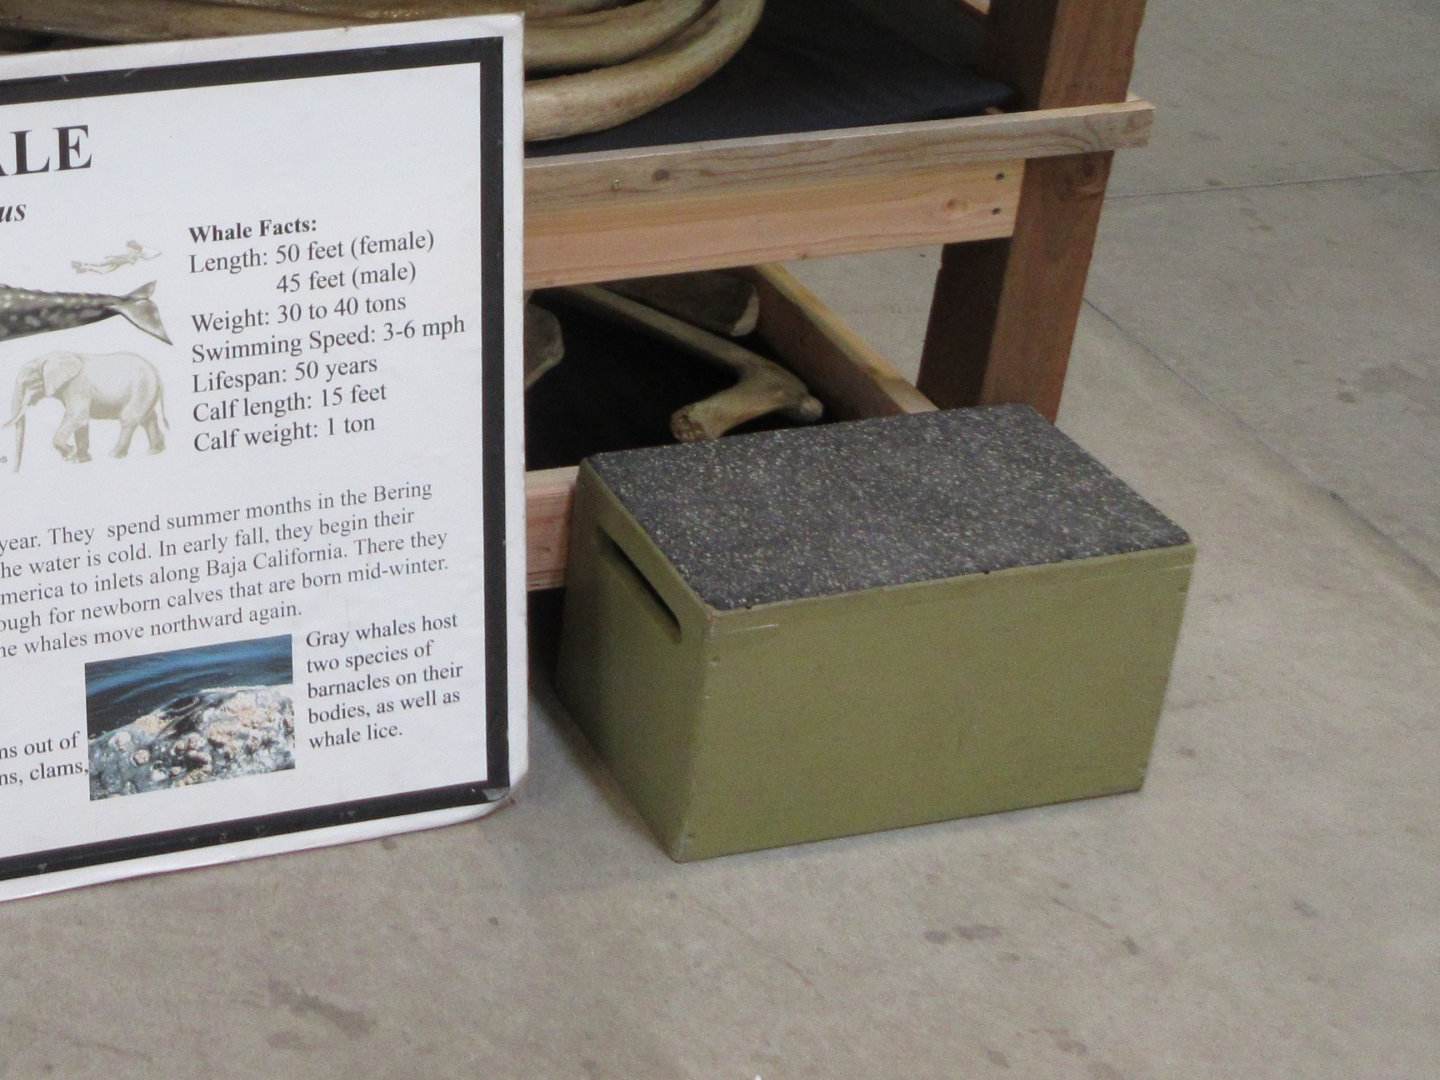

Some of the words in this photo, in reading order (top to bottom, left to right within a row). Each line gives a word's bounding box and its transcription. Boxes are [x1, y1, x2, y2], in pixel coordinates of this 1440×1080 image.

[188, 222, 252, 244] Whale
[259, 218, 316, 237] Facts:
[189, 248, 267, 274] Length:
[276, 244, 300, 264] 50
[307, 241, 344, 260] feet
[351, 230, 434, 260] (female)
[276, 273, 300, 293] 45
[309, 271, 345, 290] feet
[352, 261, 416, 289] (male)
[191, 308, 269, 334] Weight:
[278, 303, 302, 324] 30
[308, 304, 327, 320] to
[334, 297, 358, 316] 40
[365, 297, 406, 313] tons
[192, 335, 302, 363] Swimming
[309, 324, 375, 353] Speed:
[383, 320, 415, 341] 3-6
[422, 314, 465, 340] mph
[192, 369, 286, 393] Lifespan:
[295, 361, 318, 381] 50
[325, 359, 377, 383] years
[193, 399, 239, 422] Calf
[243, 392, 311, 418] length:
[322, 387, 343, 407] 15
[351, 384, 387, 403] feet
[194, 428, 240, 452] Calf
[244, 421, 318, 447] weight:
[328, 417, 335, 435] 1
[344, 418, 375, 434] ton
[48, 526, 94, 546] They
[108, 514, 160, 541] spend
[167, 509, 240, 529] summer
[246, 496, 311, 519] months
[318, 493, 334, 509] in
[341, 489, 367, 506] the
[374, 482, 432, 502] Bering
[306, 631, 350, 648] Gray
[356, 619, 416, 640] whales
[422, 614, 458, 632] host
[307, 658, 339, 673] two
[346, 646, 408, 671] species
[414, 639, 434, 658] of
[307, 674, 390, 699] barnacles
[396, 673, 417, 686] on
[423, 662, 463, 682] their
[308, 703, 370, 724] bodies,
[376, 701, 394, 714] as
[400, 690, 436, 710] well
[443, 691, 460, 704] as
[309, 727, 360, 749] whale
[367, 723, 402, 740] lice.
